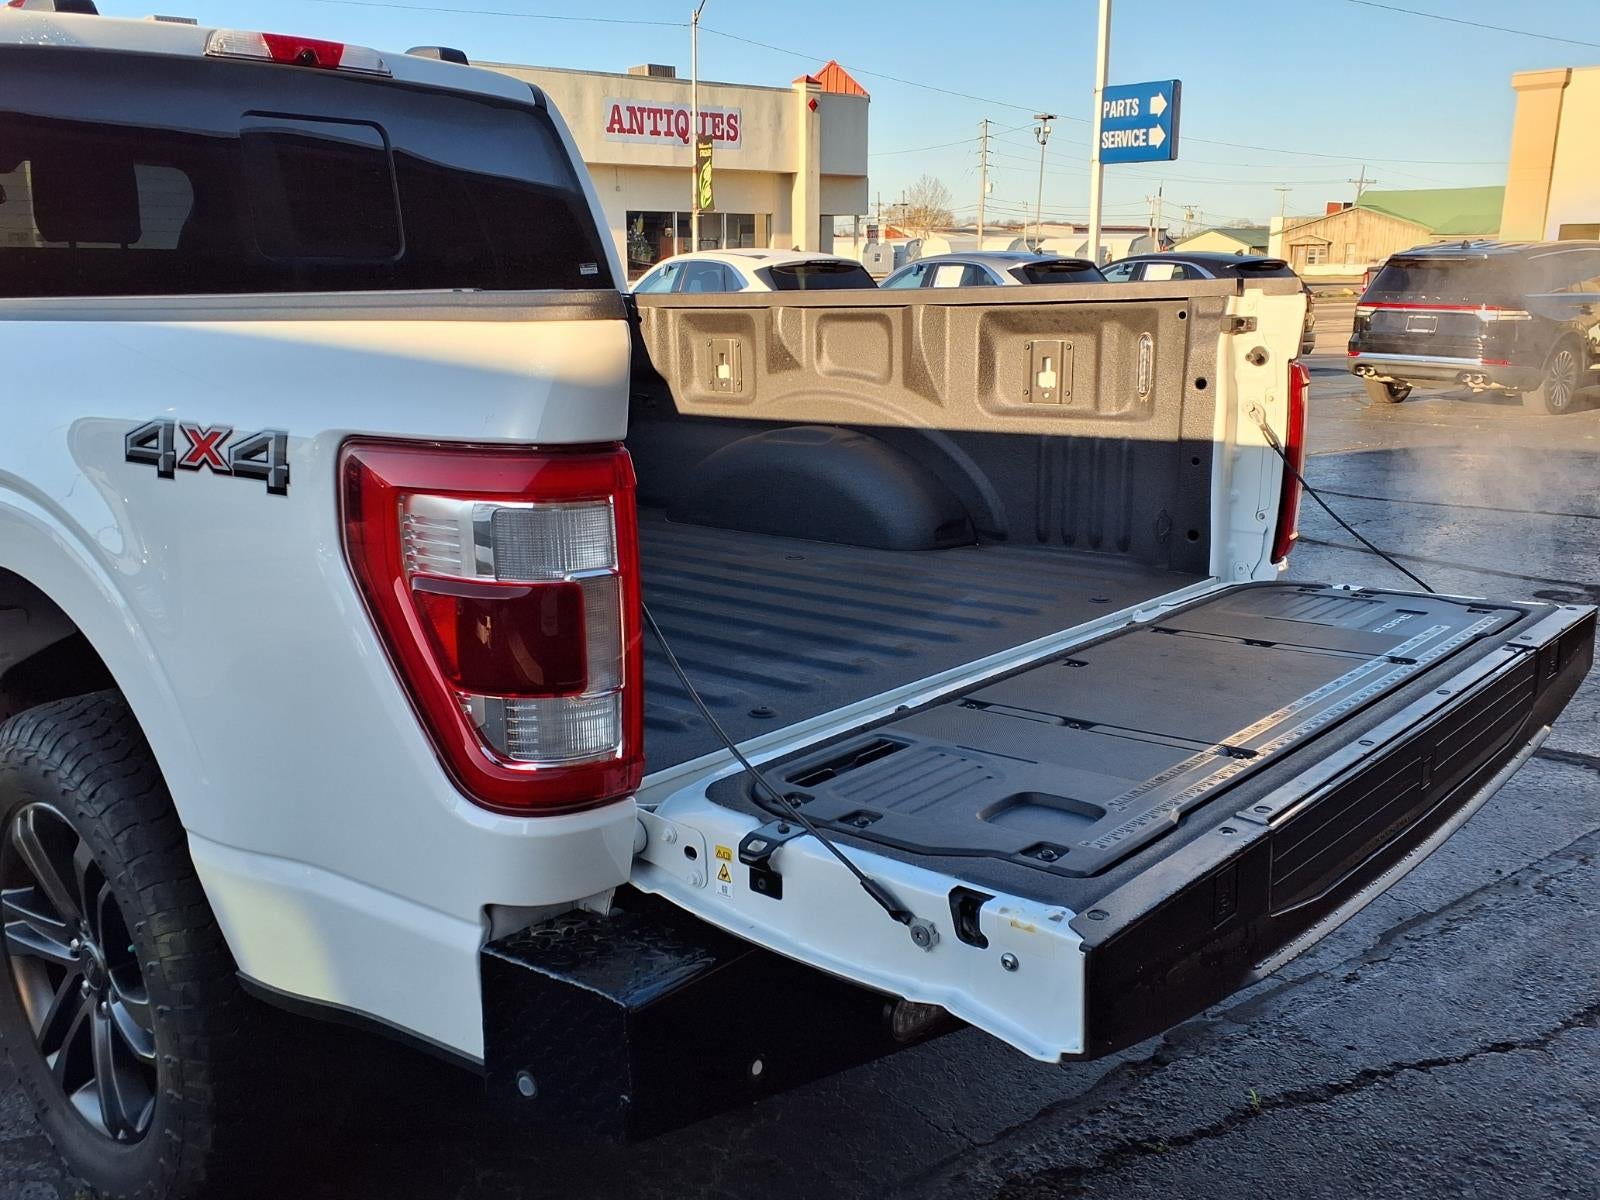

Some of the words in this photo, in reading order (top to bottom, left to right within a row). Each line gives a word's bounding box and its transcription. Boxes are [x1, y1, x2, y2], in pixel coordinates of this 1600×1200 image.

[1103, 98, 1140, 119] PARTS
[606, 104, 739, 144] ANTIQUES
[1101, 128, 1148, 149] SERVICE
